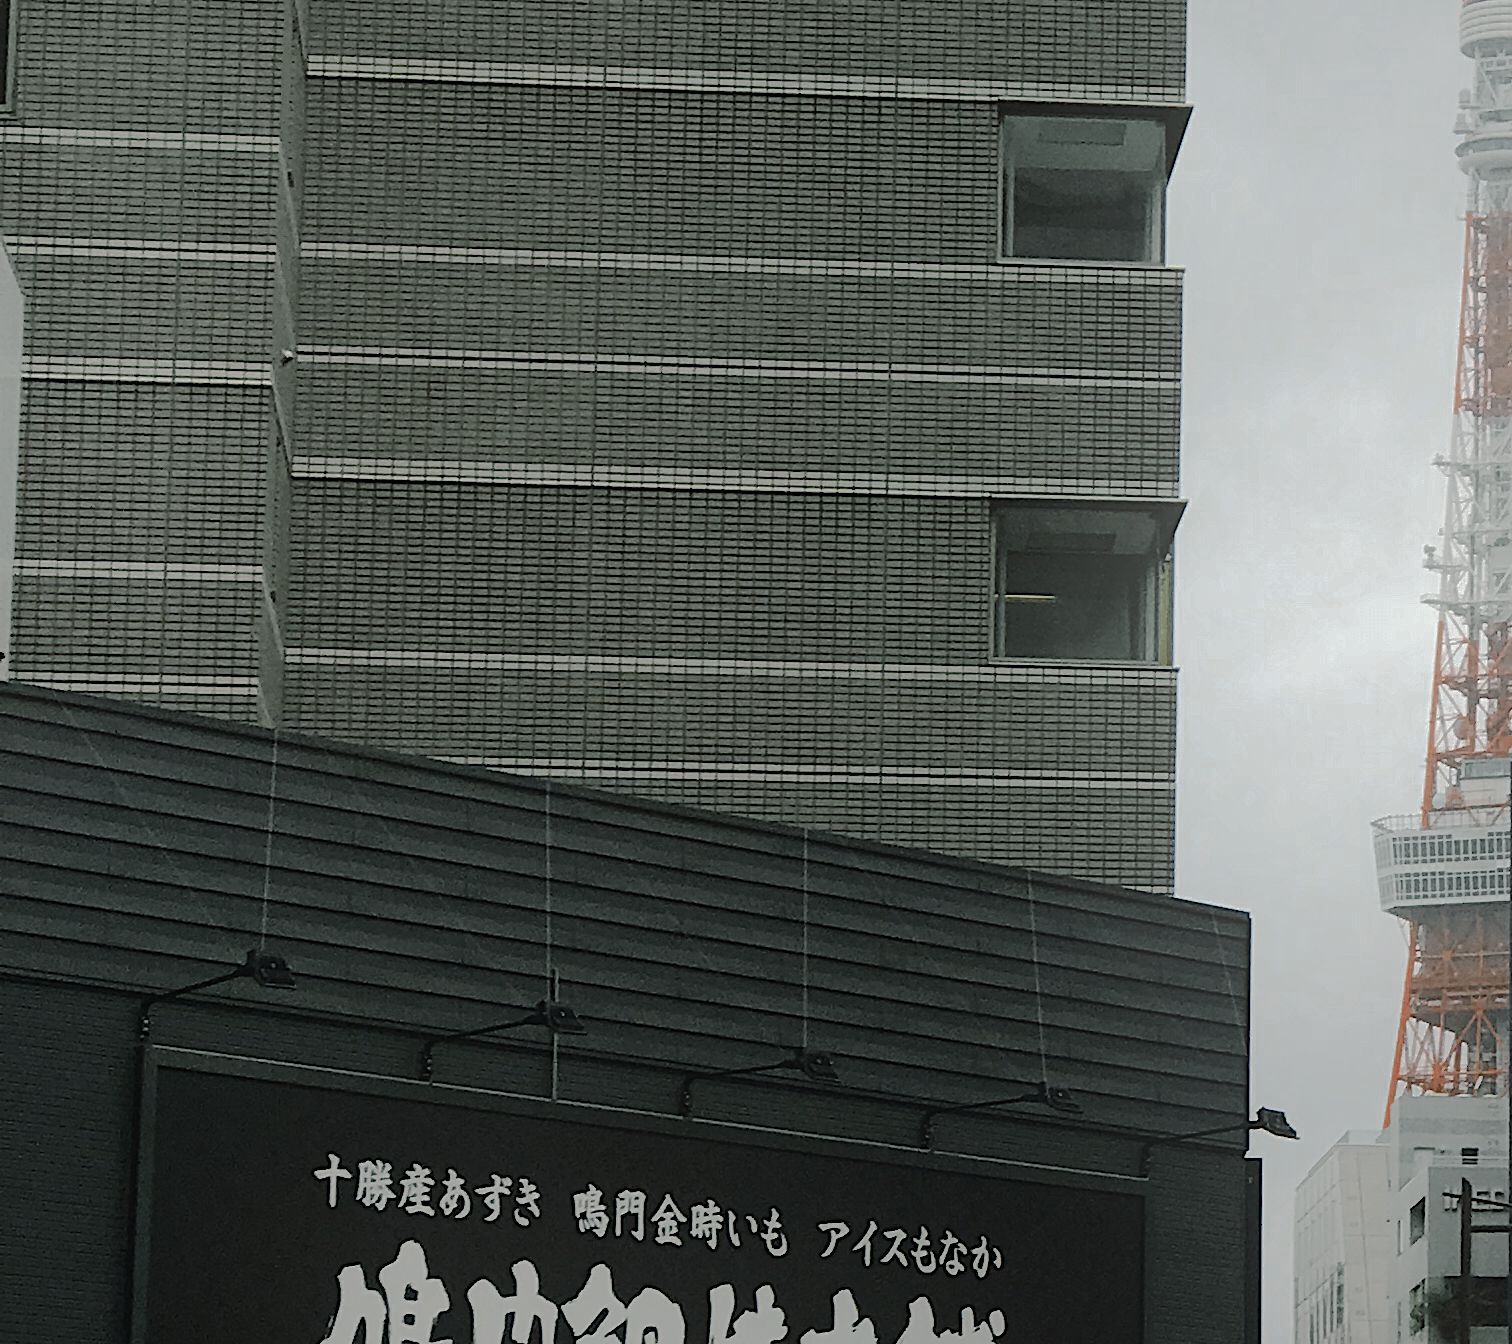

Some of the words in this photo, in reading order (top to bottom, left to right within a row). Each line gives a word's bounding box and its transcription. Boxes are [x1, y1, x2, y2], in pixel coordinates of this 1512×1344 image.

[313, 1153, 542, 1227] 十勝産あずき
[573, 1183, 788, 1257] 鳴門金時いも
[818, 1219, 1003, 1278] アイスもなか
